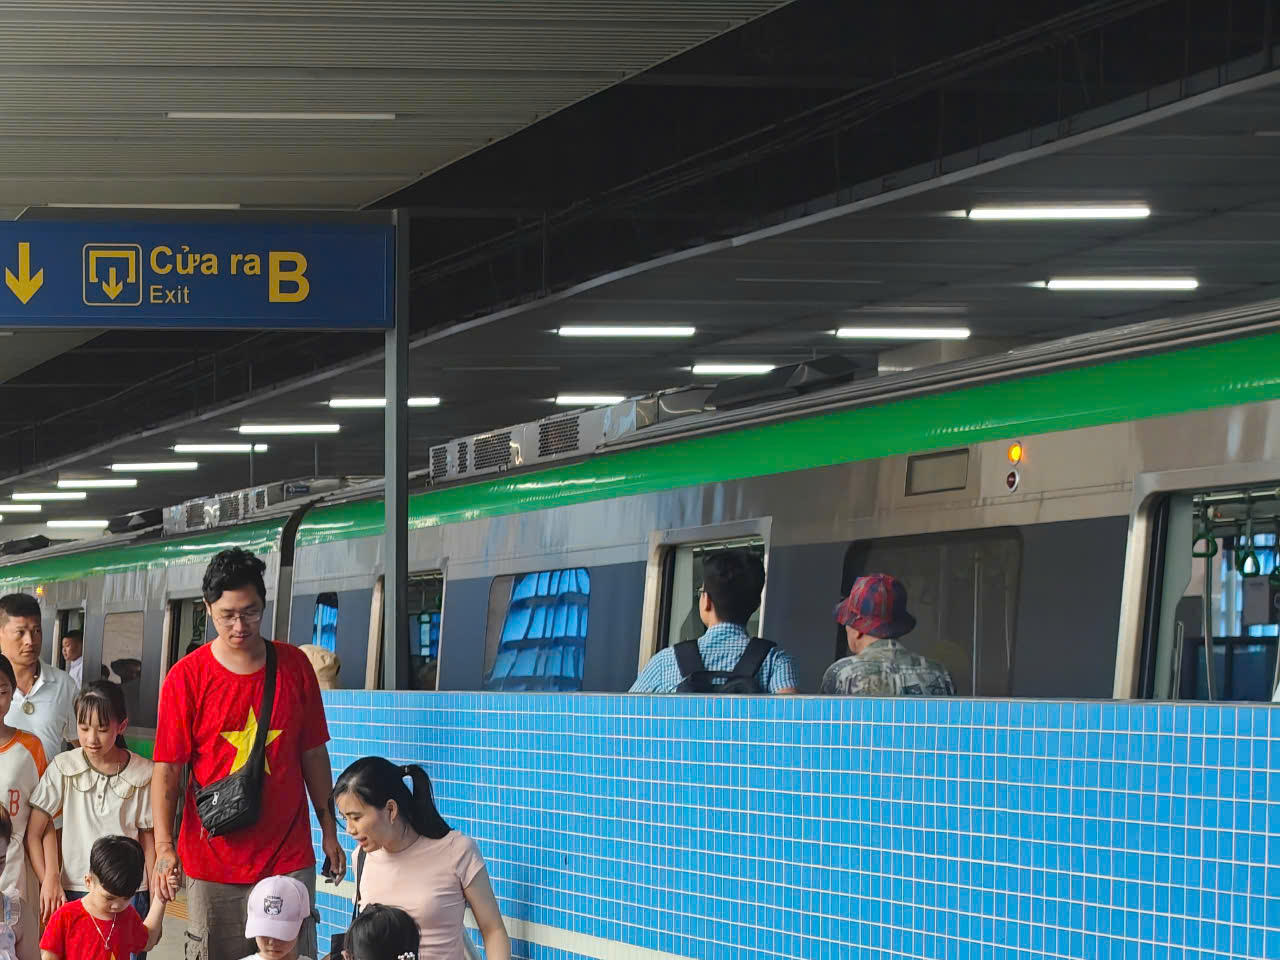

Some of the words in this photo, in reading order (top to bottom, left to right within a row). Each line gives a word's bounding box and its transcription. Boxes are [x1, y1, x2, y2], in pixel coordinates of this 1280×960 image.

[150, 245, 218, 275] Cửa
[230, 253, 261, 275] ra
[269, 251, 310, 302] B
[150, 285, 190, 304] Exit
[8, 789, 20, 816] B
